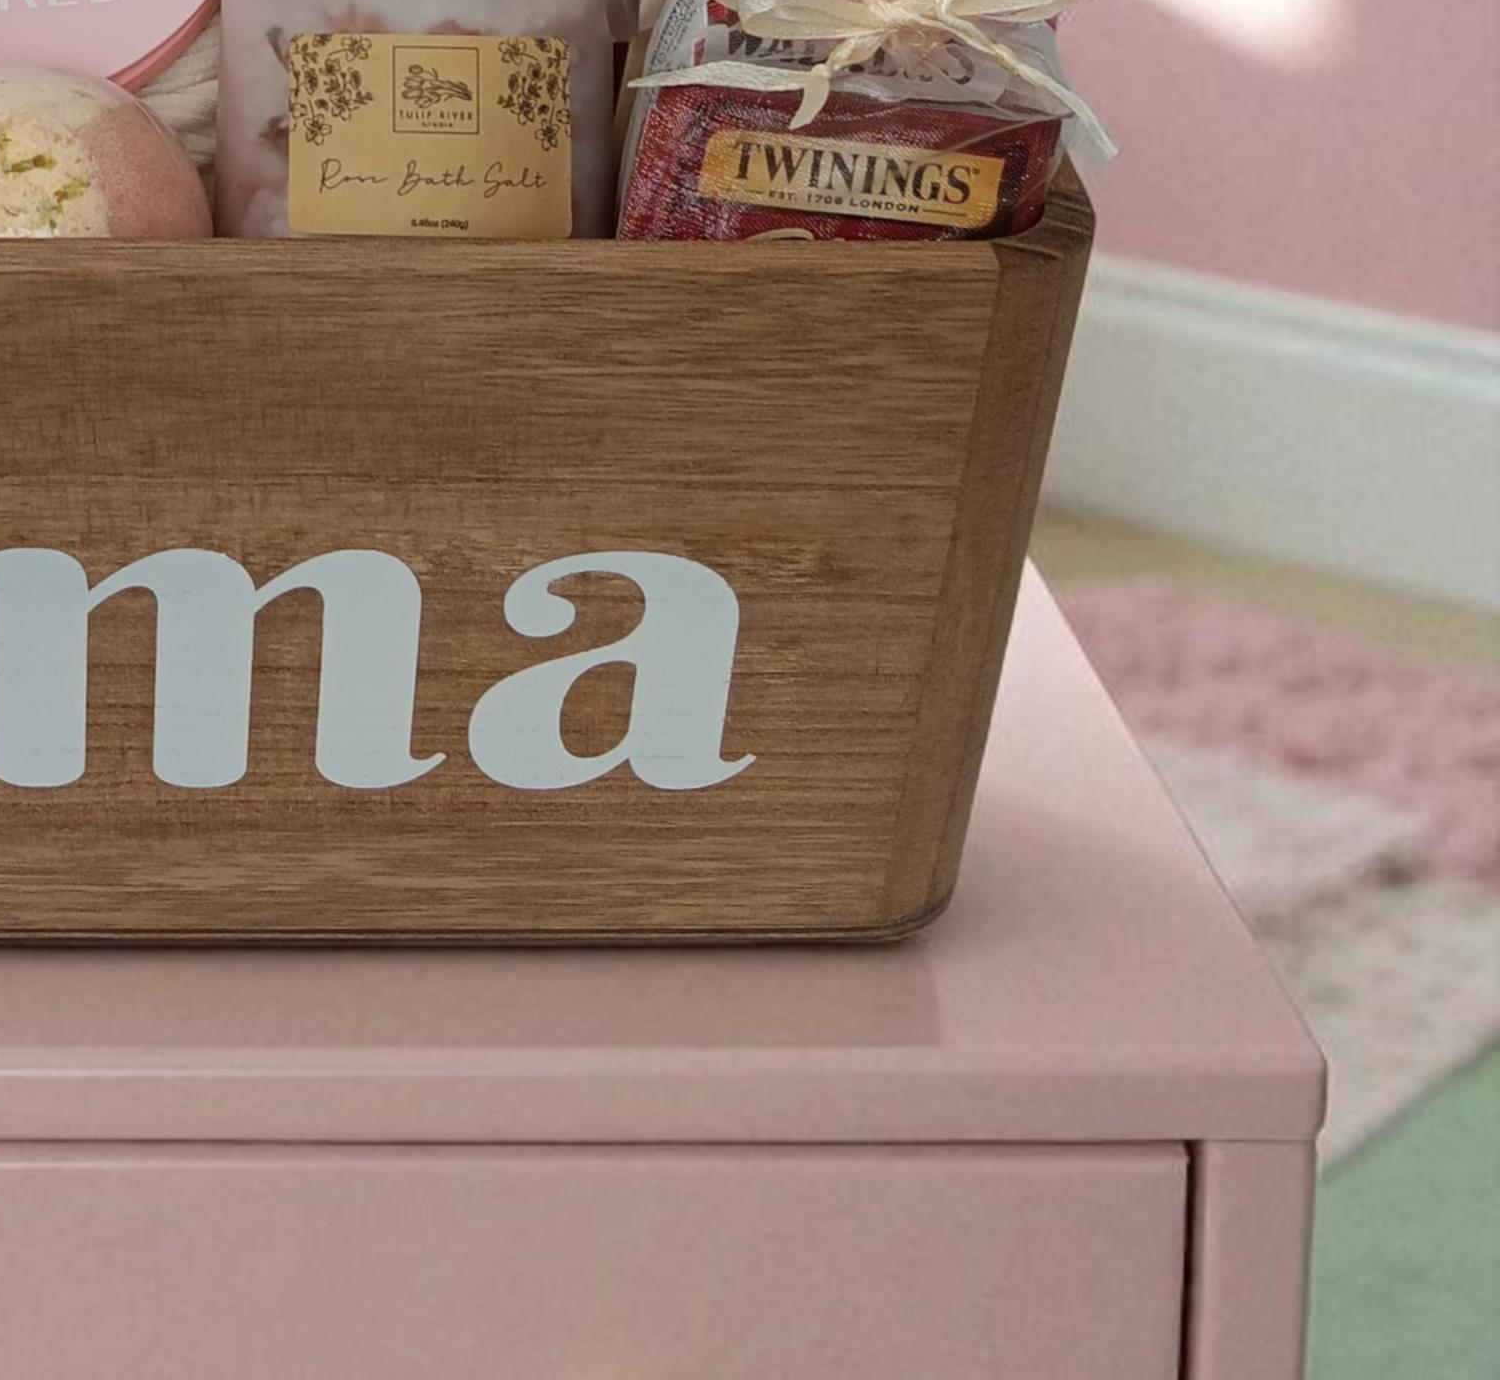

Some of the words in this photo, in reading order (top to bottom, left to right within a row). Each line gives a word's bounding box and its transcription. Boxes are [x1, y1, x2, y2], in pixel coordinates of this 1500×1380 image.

[399, 110, 432, 120] TULIP
[439, 111, 473, 121] RIVER
[318, 158, 389, 193] Rose
[397, 159, 475, 196] Bath
[483, 161, 548, 198] Salt
[733, 140, 974, 205] TWININGS
[768, 190, 799, 201] EST.
[849, 197, 920, 214] LONDON
